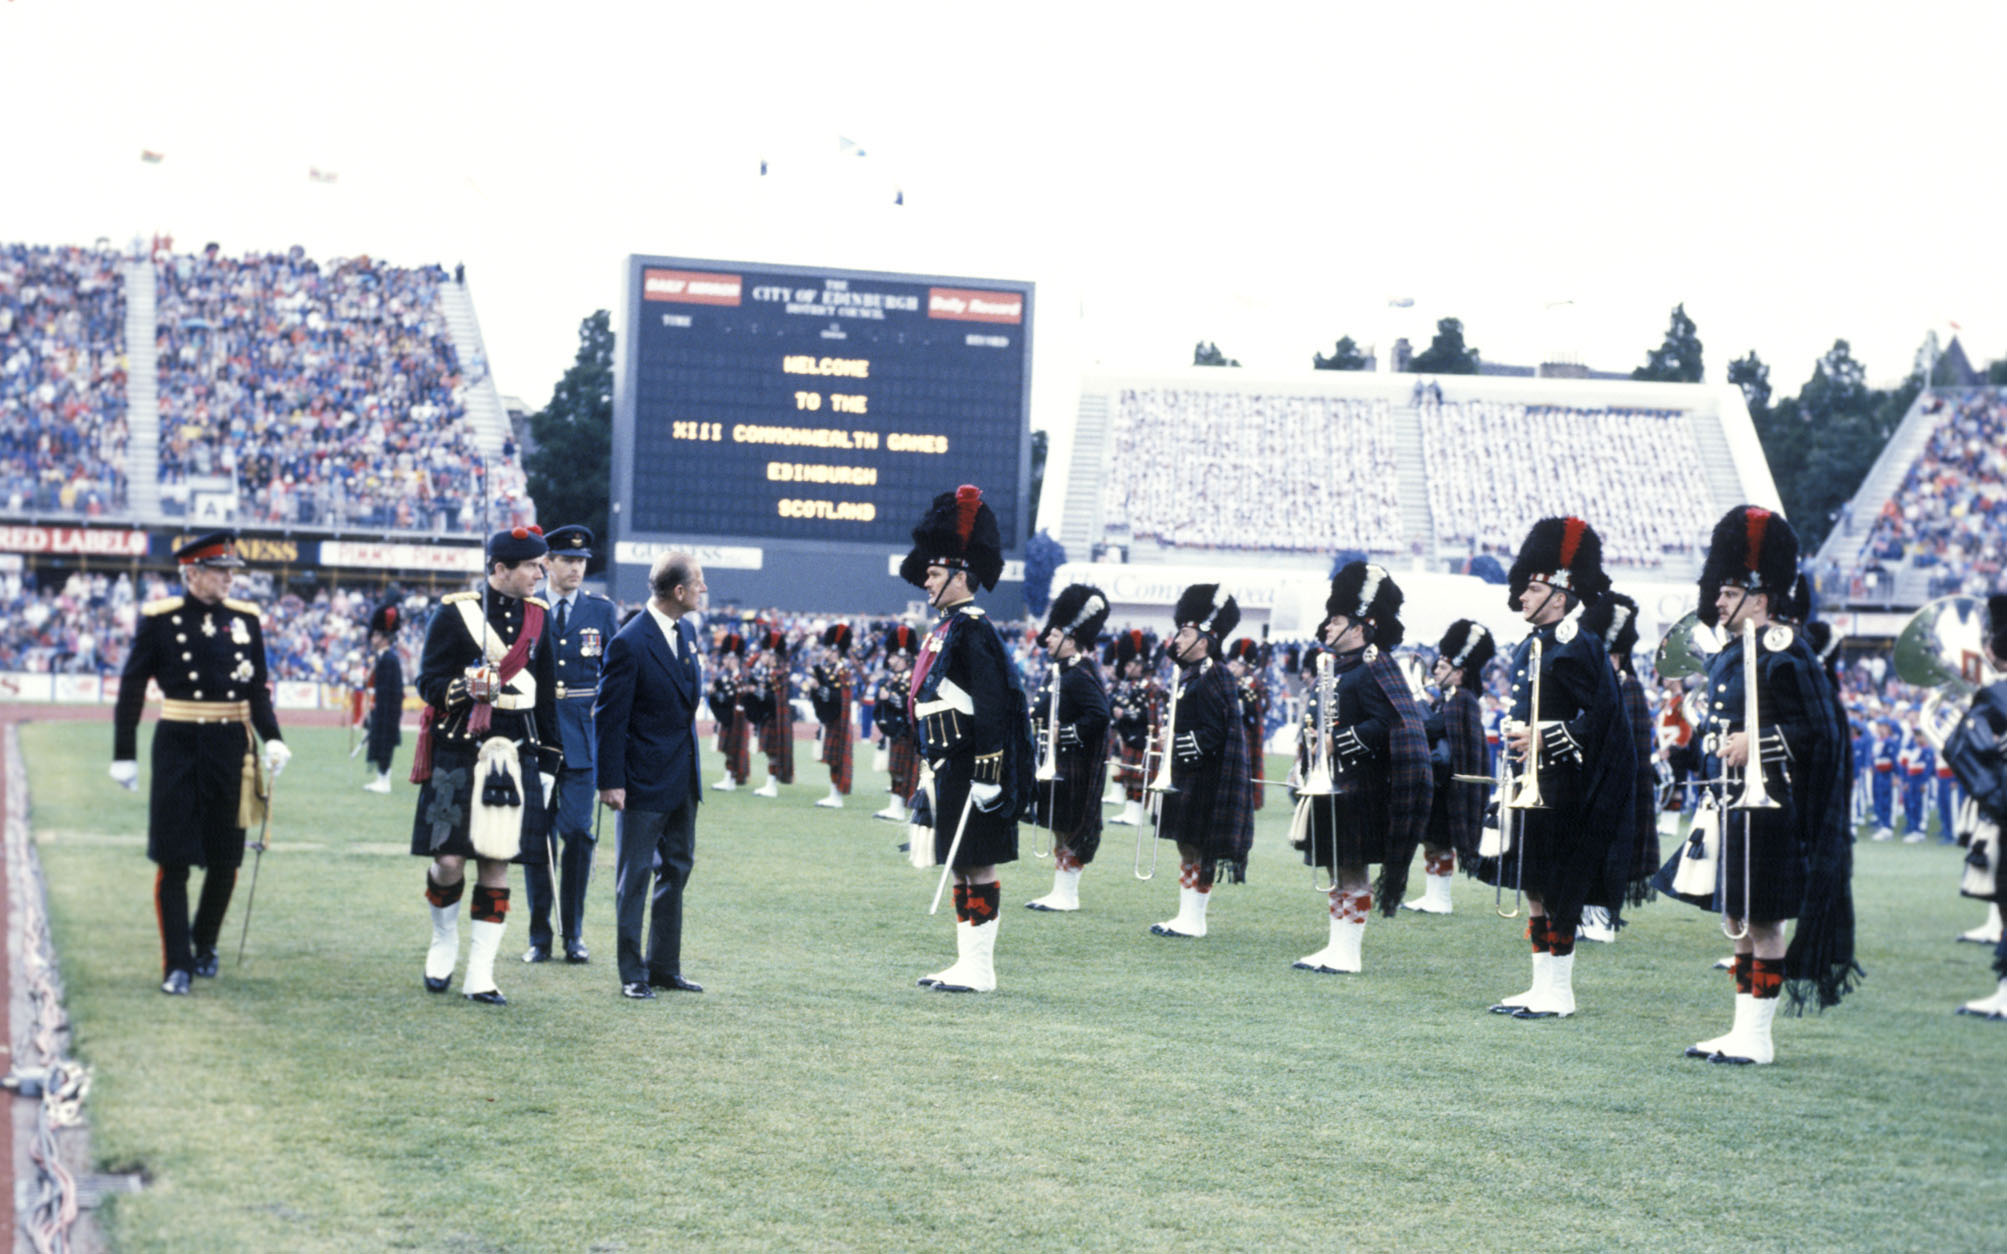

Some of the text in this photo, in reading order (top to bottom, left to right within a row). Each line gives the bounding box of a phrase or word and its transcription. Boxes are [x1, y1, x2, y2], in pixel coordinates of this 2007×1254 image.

[752, 286, 919, 311] CITY OF EDINBURGH
[783, 355, 869, 378] WELCOME
[794, 391, 868, 414] TO THE
[672, 421, 949, 453] XIII COMMONWEALTH GAMES
[766, 461, 878, 486] EDINBURGH
[777, 498, 876, 521] SCOTLAND
[51, 527, 130, 555] LABEL
